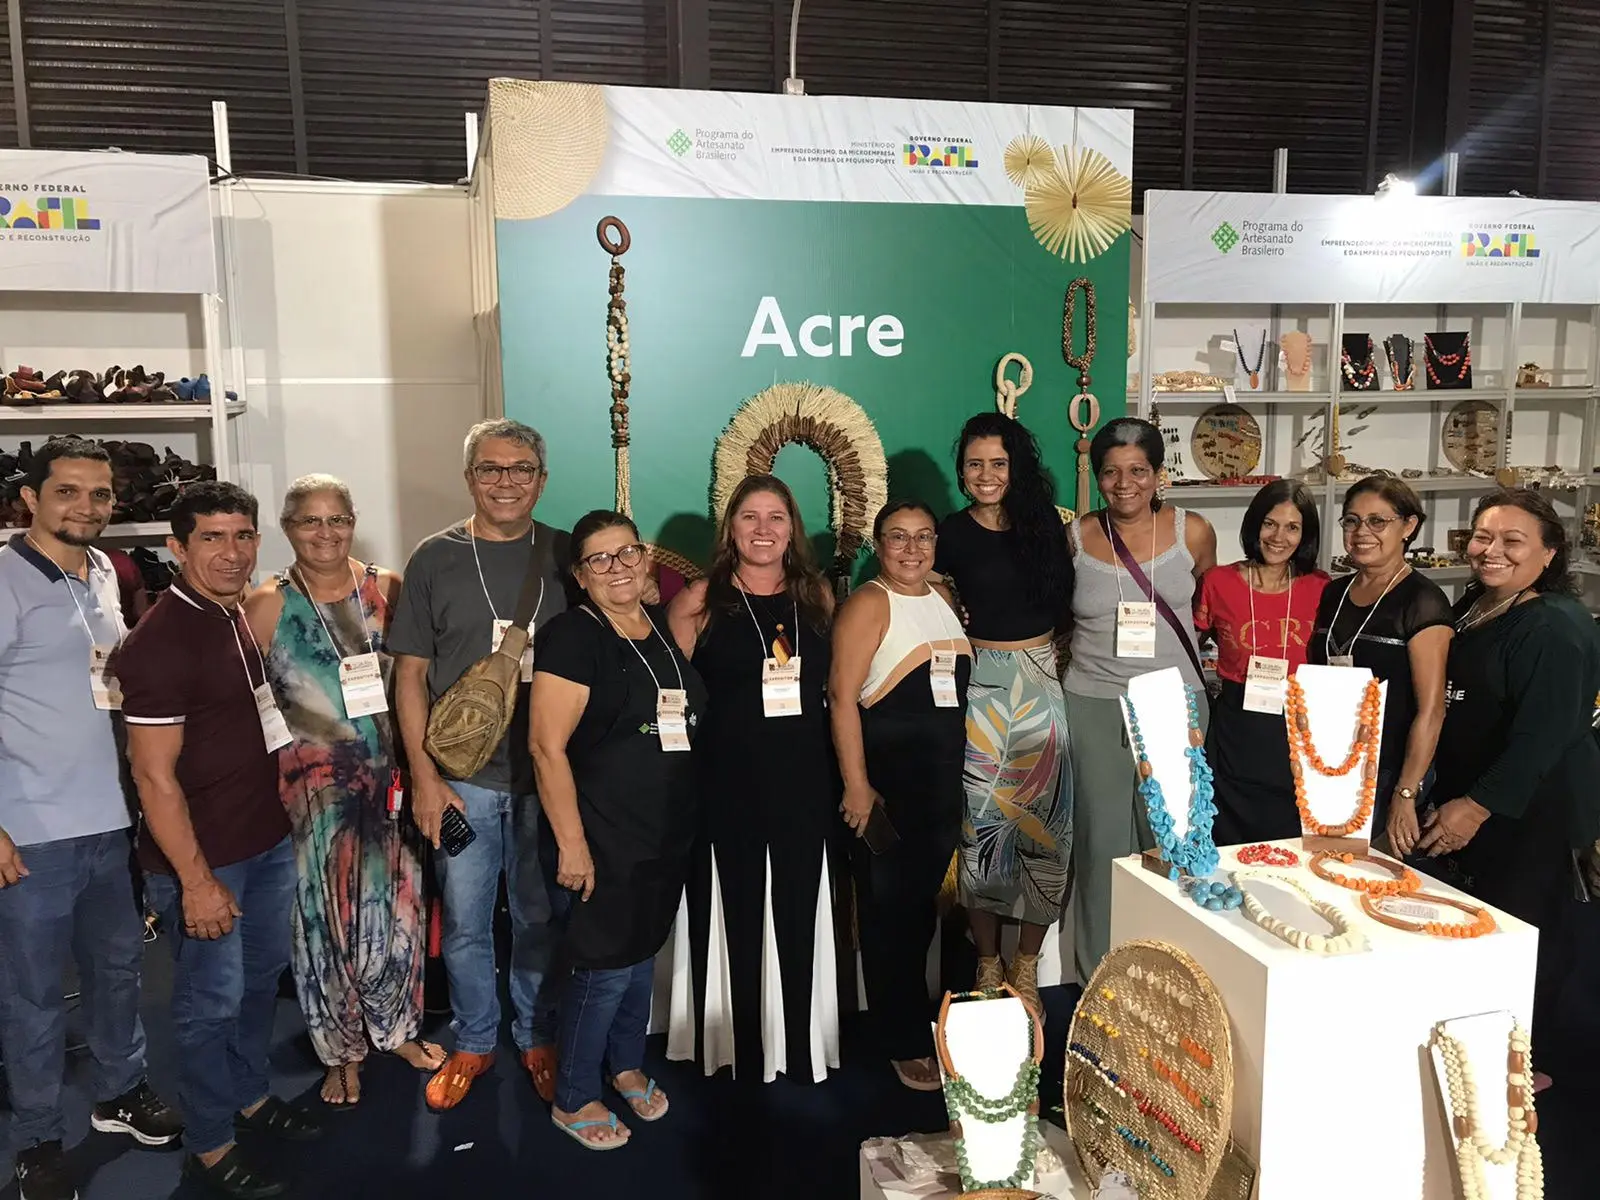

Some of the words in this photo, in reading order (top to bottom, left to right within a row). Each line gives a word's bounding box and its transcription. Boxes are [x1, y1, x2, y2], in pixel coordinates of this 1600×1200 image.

[696, 128, 739, 141] Programa
[741, 130, 754, 140] do
[696, 139, 745, 150] Artesanato
[696, 150, 737, 161] Brasileiro
[903, 143, 979, 168] BRASIL
[34, 184, 87, 193] FEDERAL
[1242, 220, 1288, 234] Programa
[1291, 219, 1304, 232] do
[1504, 223, 1535, 231] FEDERAL
[18, 234, 91, 243] RECONSTRUÇÃO
[1241, 232, 1294, 244] Artesanato
[1242, 245, 1285, 256] Brasileiro
[1461, 232, 1541, 258] BRASIL
[740, 296, 905, 358] Acre
